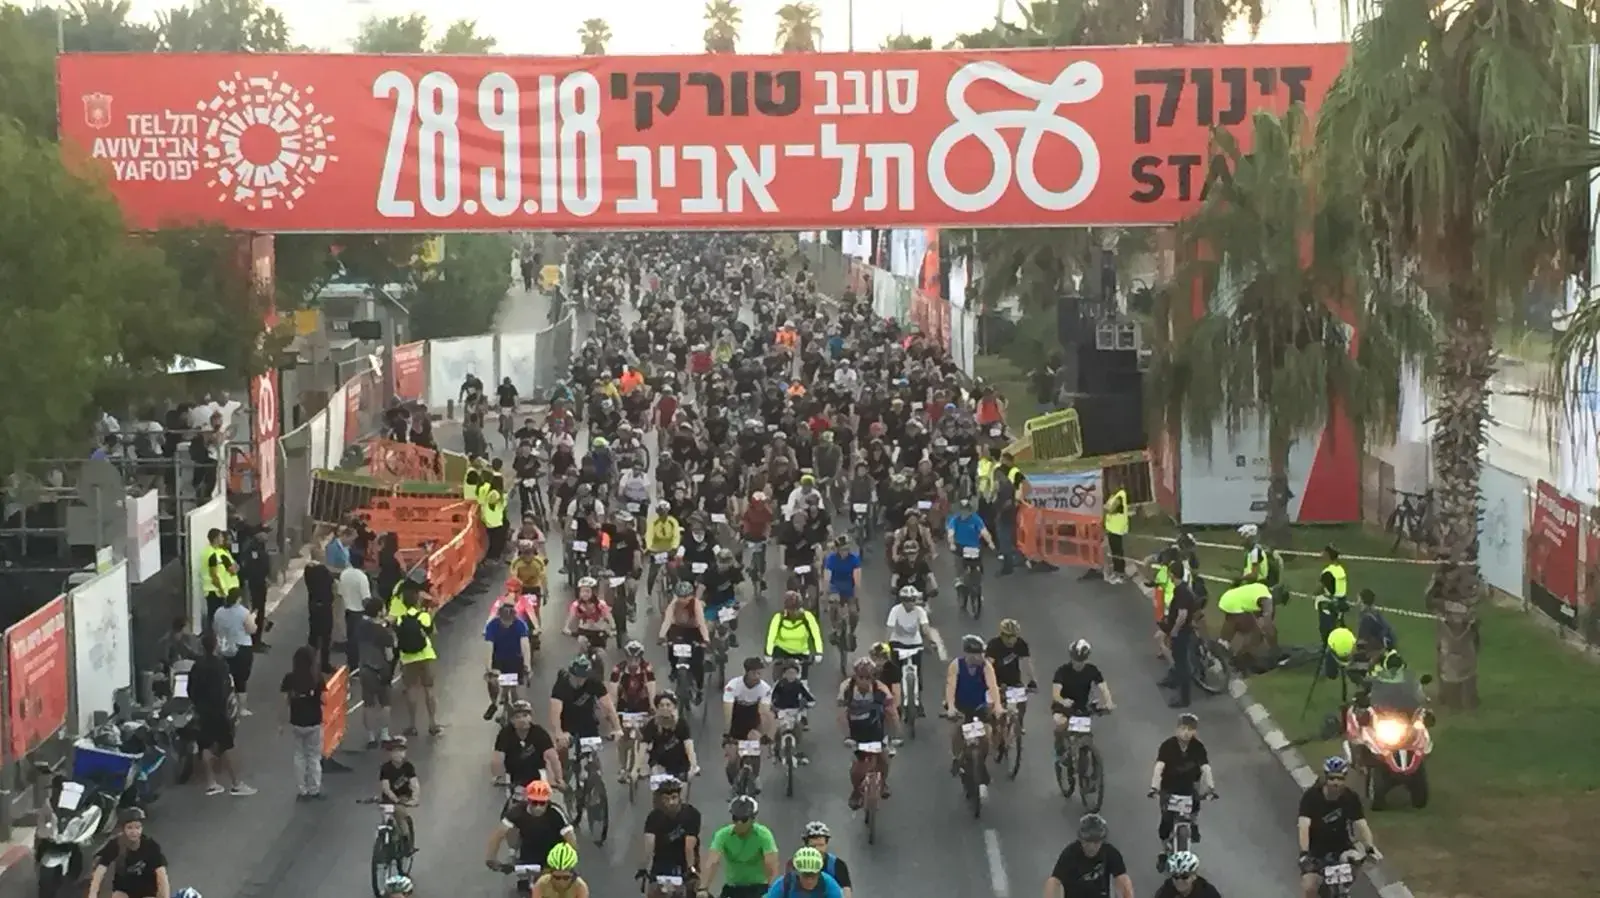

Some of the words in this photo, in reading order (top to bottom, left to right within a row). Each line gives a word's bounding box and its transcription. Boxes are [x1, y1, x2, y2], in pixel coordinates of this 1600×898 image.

[610, 70, 801, 132] טורקי
[814, 70, 919, 115] סובב
[1134, 67, 1312, 144] זינוק
[127, 114, 166, 135] TEL
[165, 109, 198, 135] תל
[92, 137, 142, 158] AVIV
[143, 137, 199, 158] אביב
[373, 71, 602, 217] 28.9.18
[112, 160, 167, 181] YAFO
[168, 160, 199, 181] יפו
[1130, 154, 1254, 203] STA
